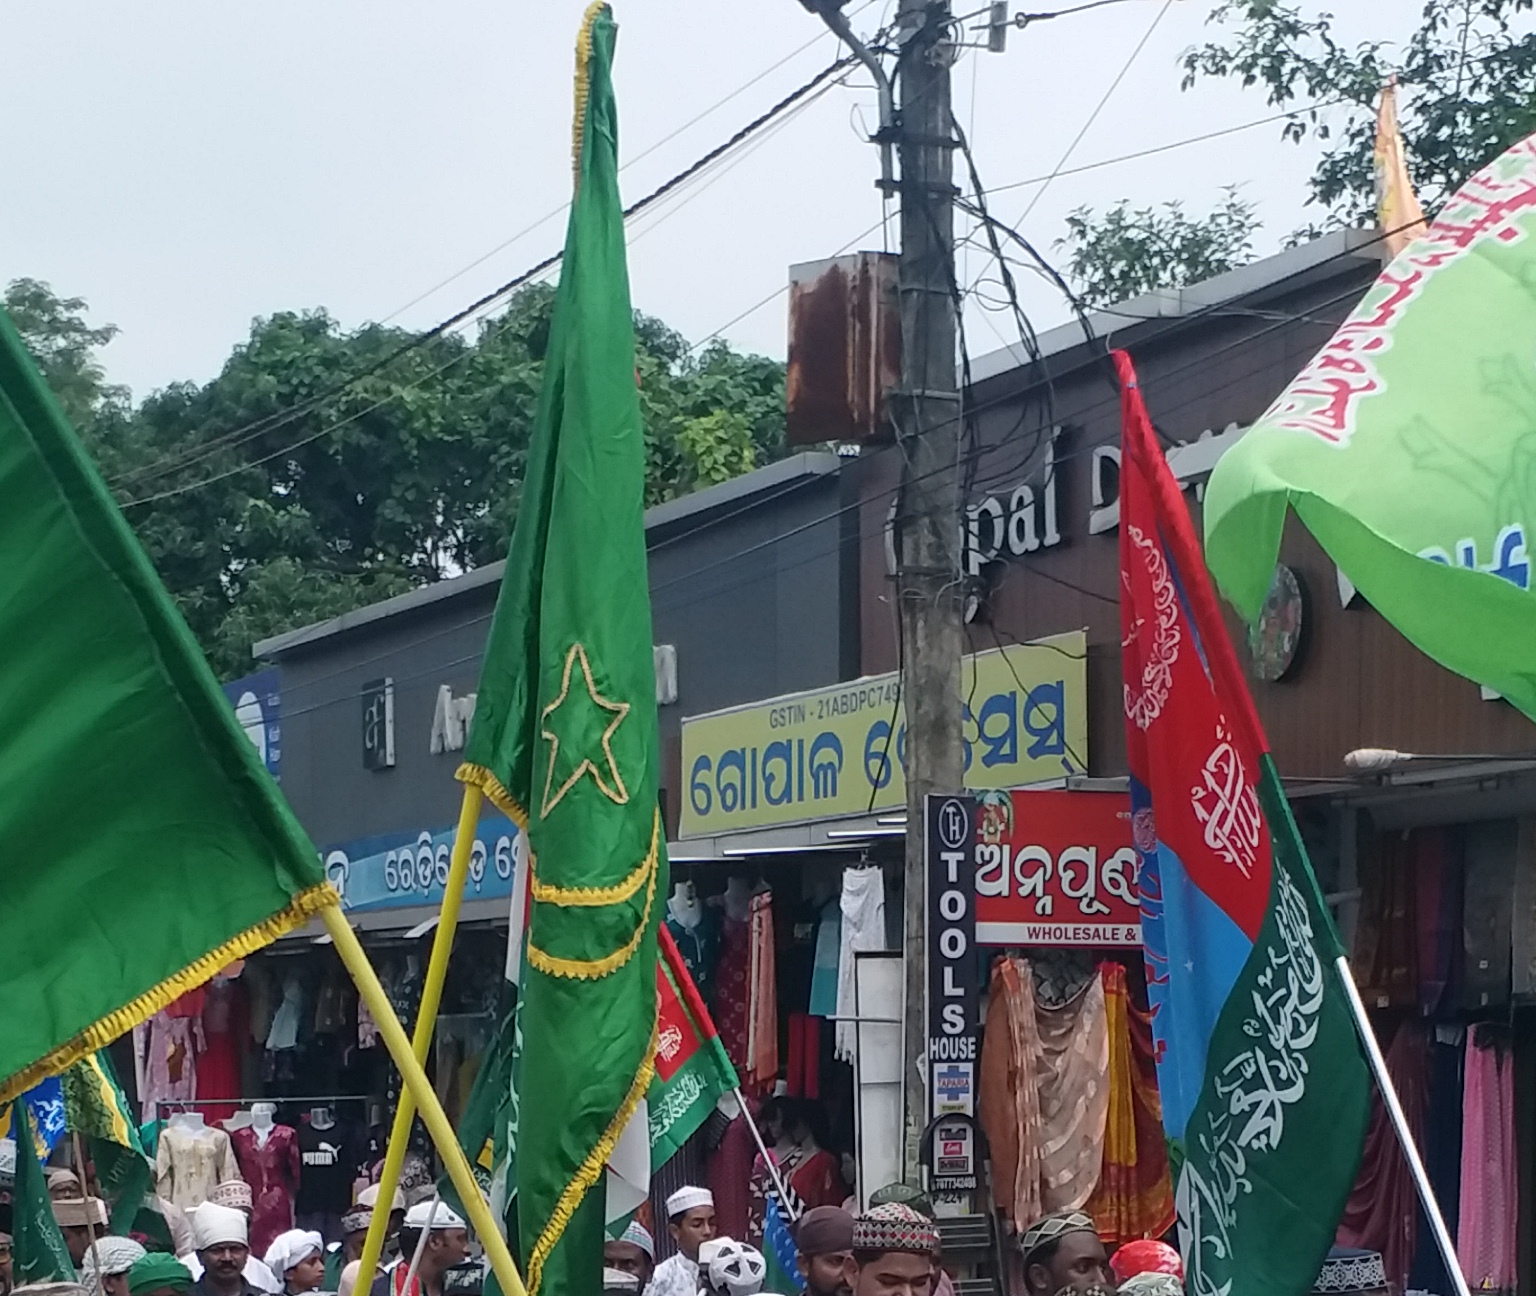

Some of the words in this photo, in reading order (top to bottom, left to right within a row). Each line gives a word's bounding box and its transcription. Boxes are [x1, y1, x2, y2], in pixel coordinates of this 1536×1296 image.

[769, 704, 806, 729] GSTIN
[690, 731, 844, 817] ଗୋପାଳ
[939, 851, 967, 1035] TOOLS
[1027, 926, 1120, 941] WHOLESALE
[1124, 926, 1137, 941] &
[929, 1036, 977, 1060] HOUSE
